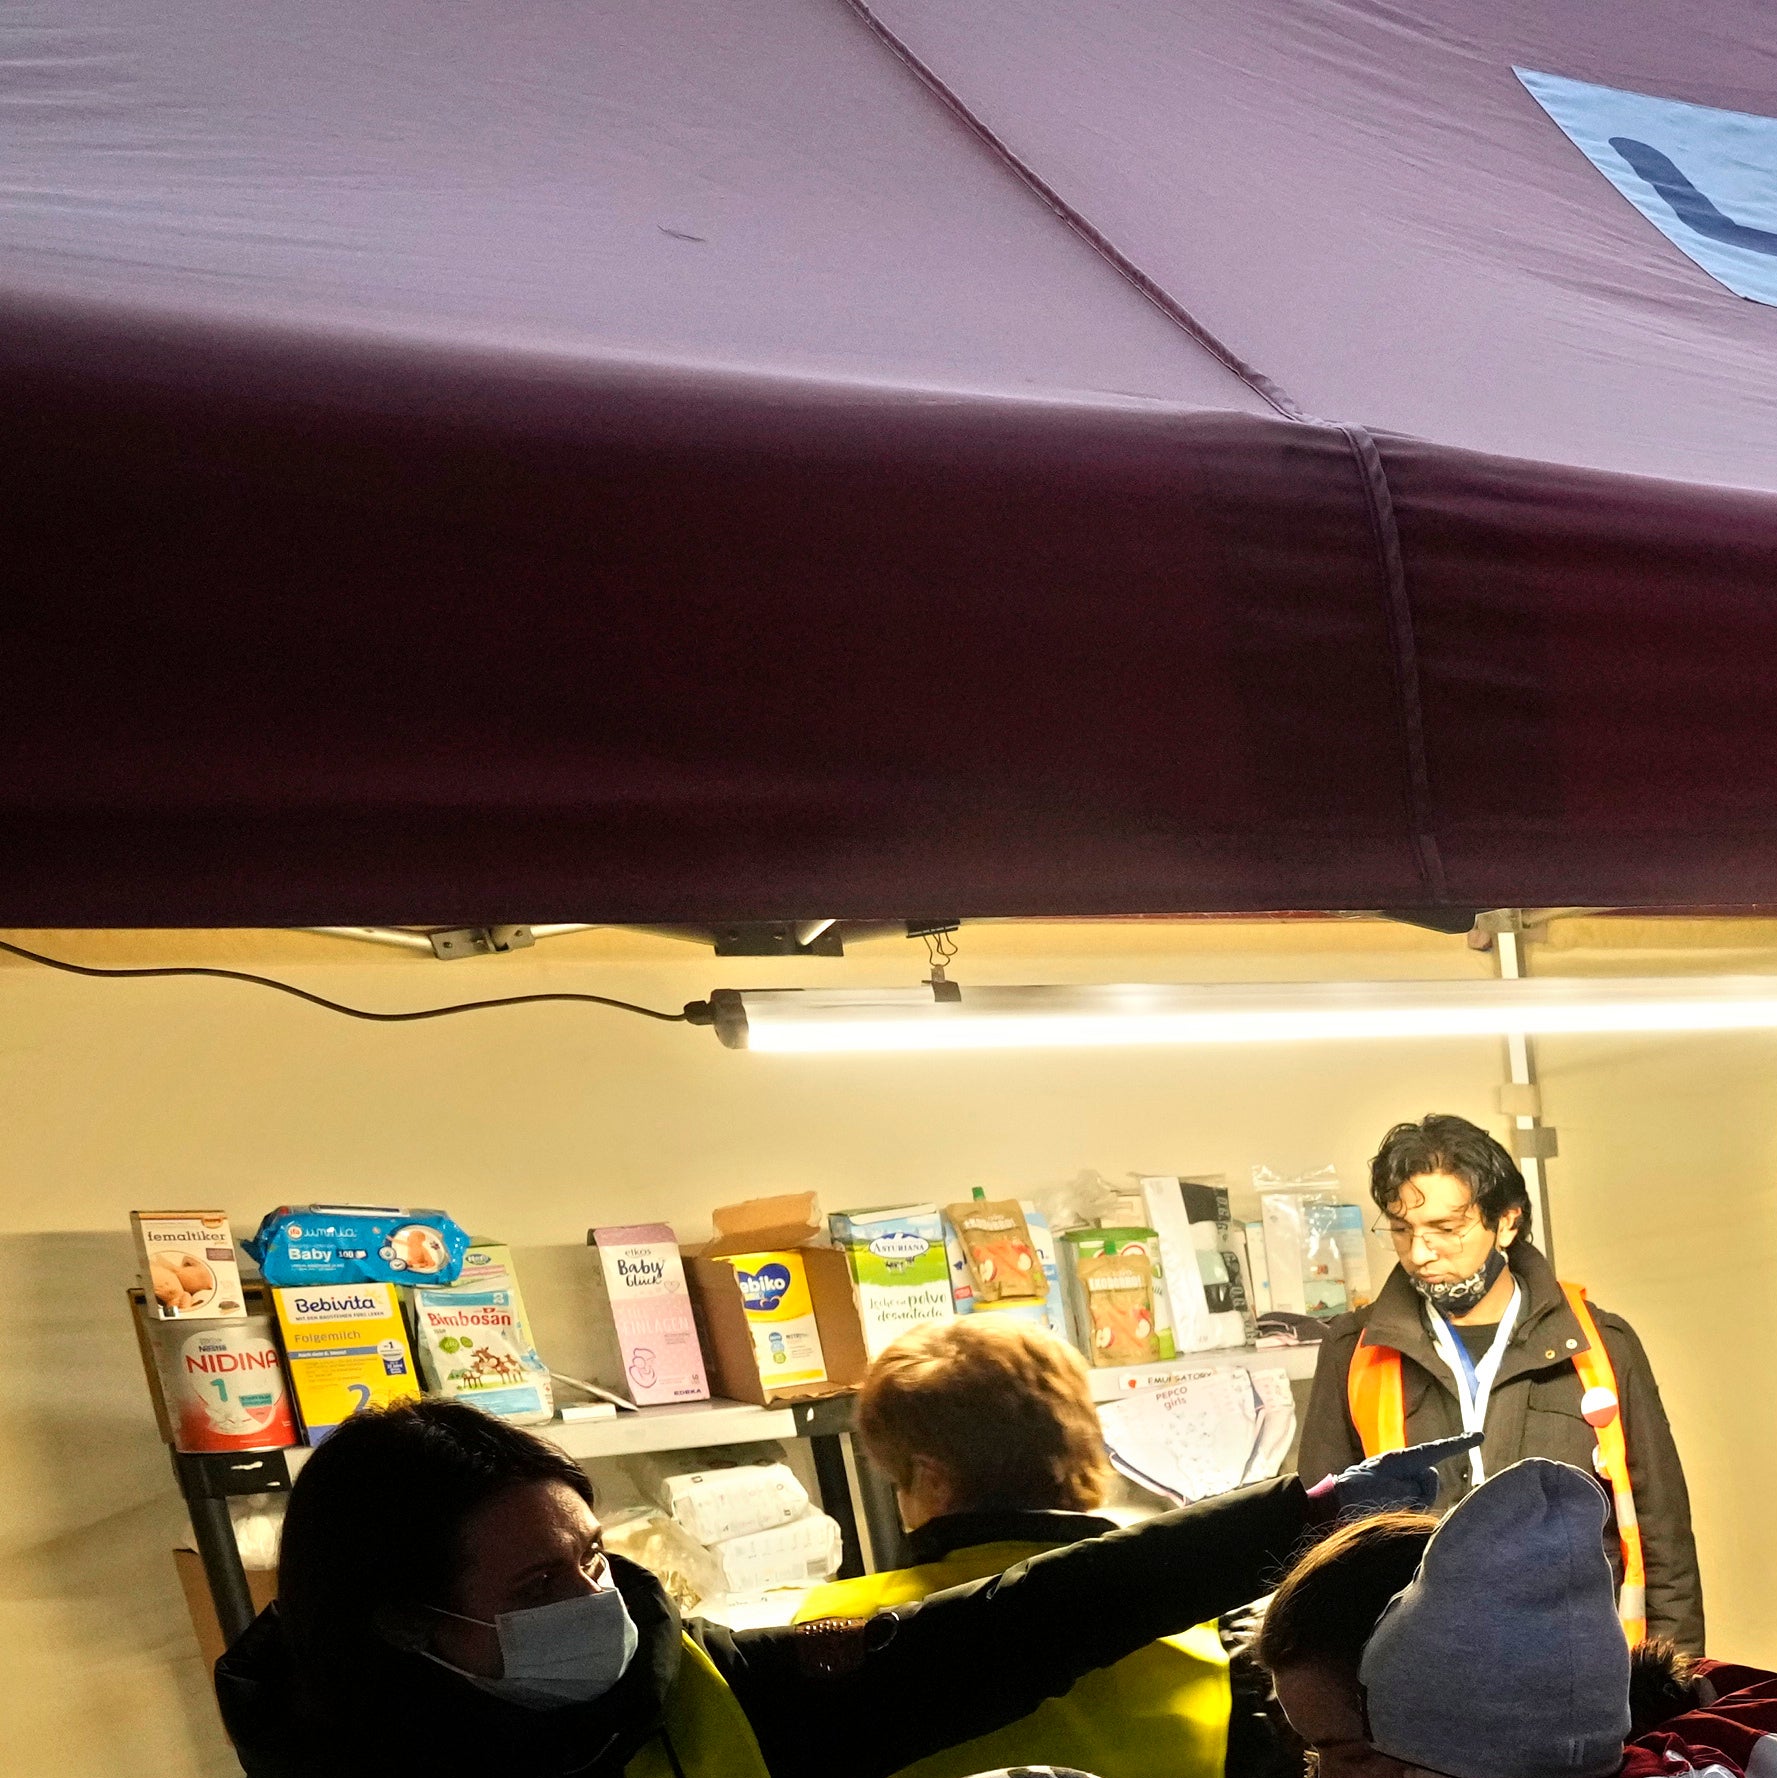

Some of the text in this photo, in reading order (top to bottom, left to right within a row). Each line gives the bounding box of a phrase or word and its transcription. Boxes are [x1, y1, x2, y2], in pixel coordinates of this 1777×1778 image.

[147, 1230, 226, 1243] femaltiker
[288, 1247, 332, 1263] Baby
[617, 1257, 665, 1279] Baby
[739, 1275, 786, 1294] ebiko
[294, 1295, 376, 1314] Bebivita
[427, 1311, 512, 1327] Bimbosan
[294, 1331, 361, 1343] Folgemilch
[185, 1349, 280, 1374] NIDINA
[210, 1378, 229, 1403] 1
[347, 1383, 372, 1412] 2
[1155, 1386, 1188, 1401] PEPCO
[1163, 1396, 1188, 1412] girls
